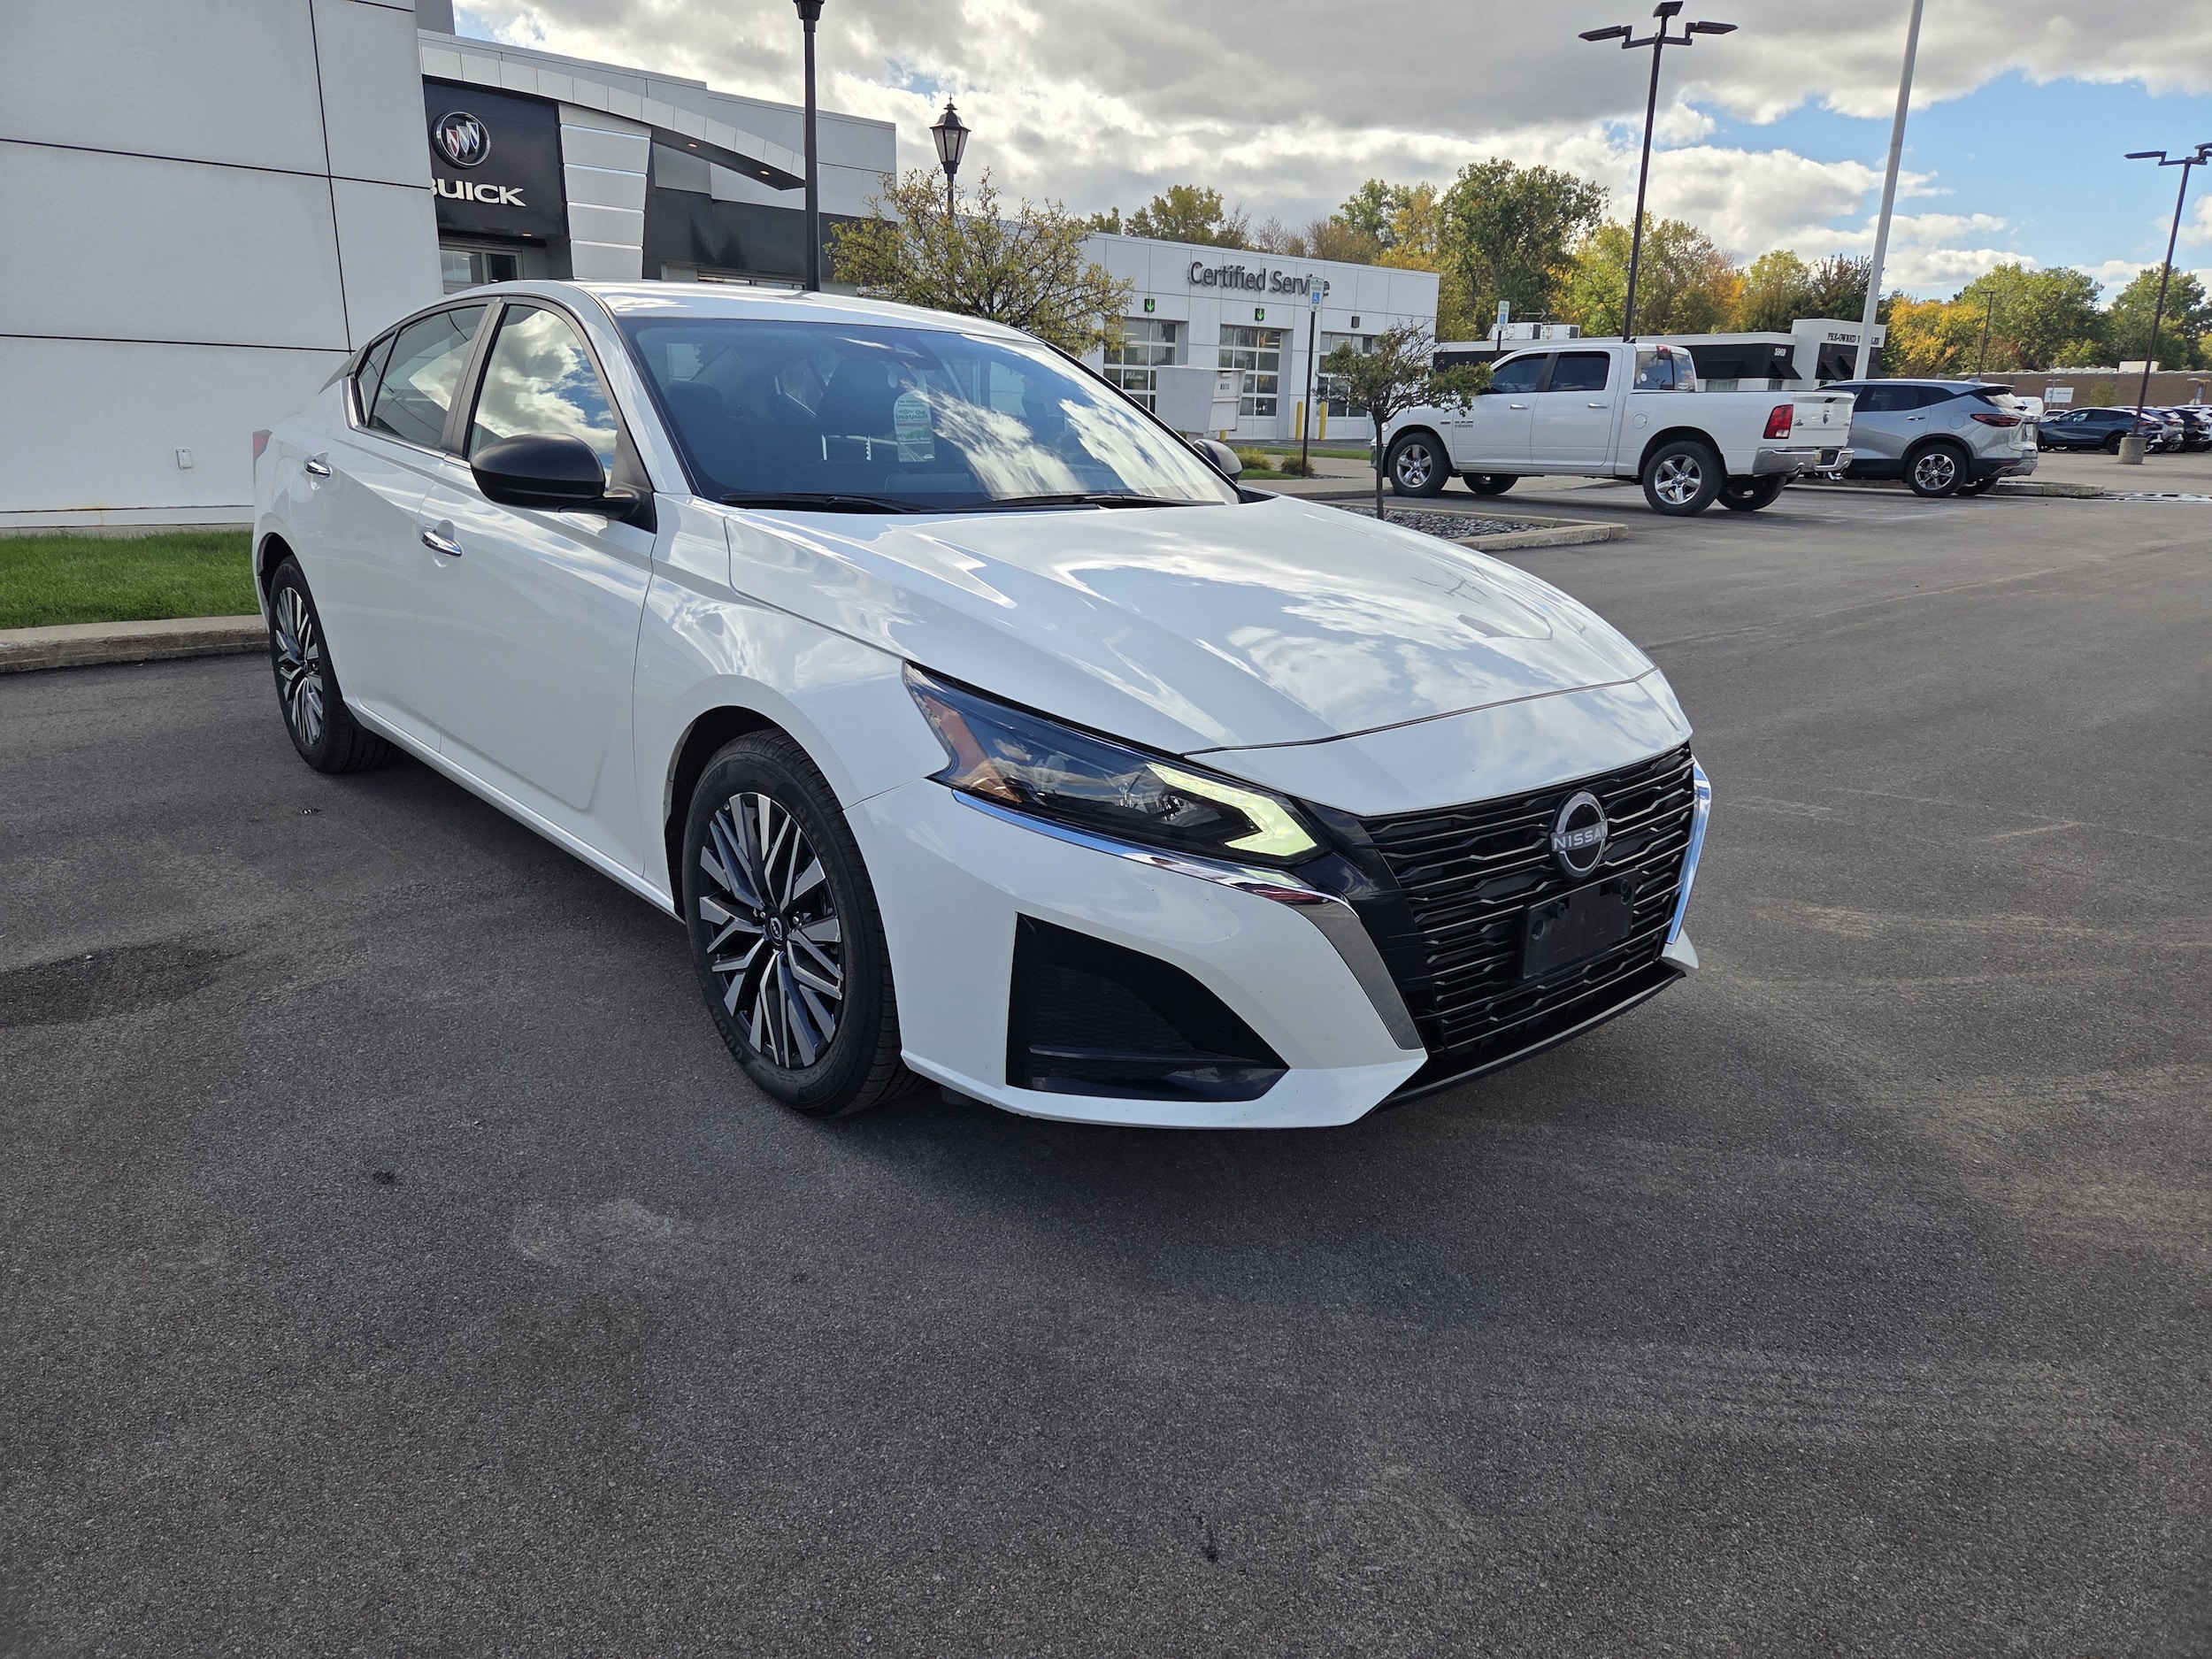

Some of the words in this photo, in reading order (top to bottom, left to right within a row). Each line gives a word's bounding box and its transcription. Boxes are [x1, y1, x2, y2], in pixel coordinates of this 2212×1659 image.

[1189, 261, 1266, 291] Certified
[1271, 270, 1330, 296] Servie
[1554, 825, 1608, 850] NISSAN
